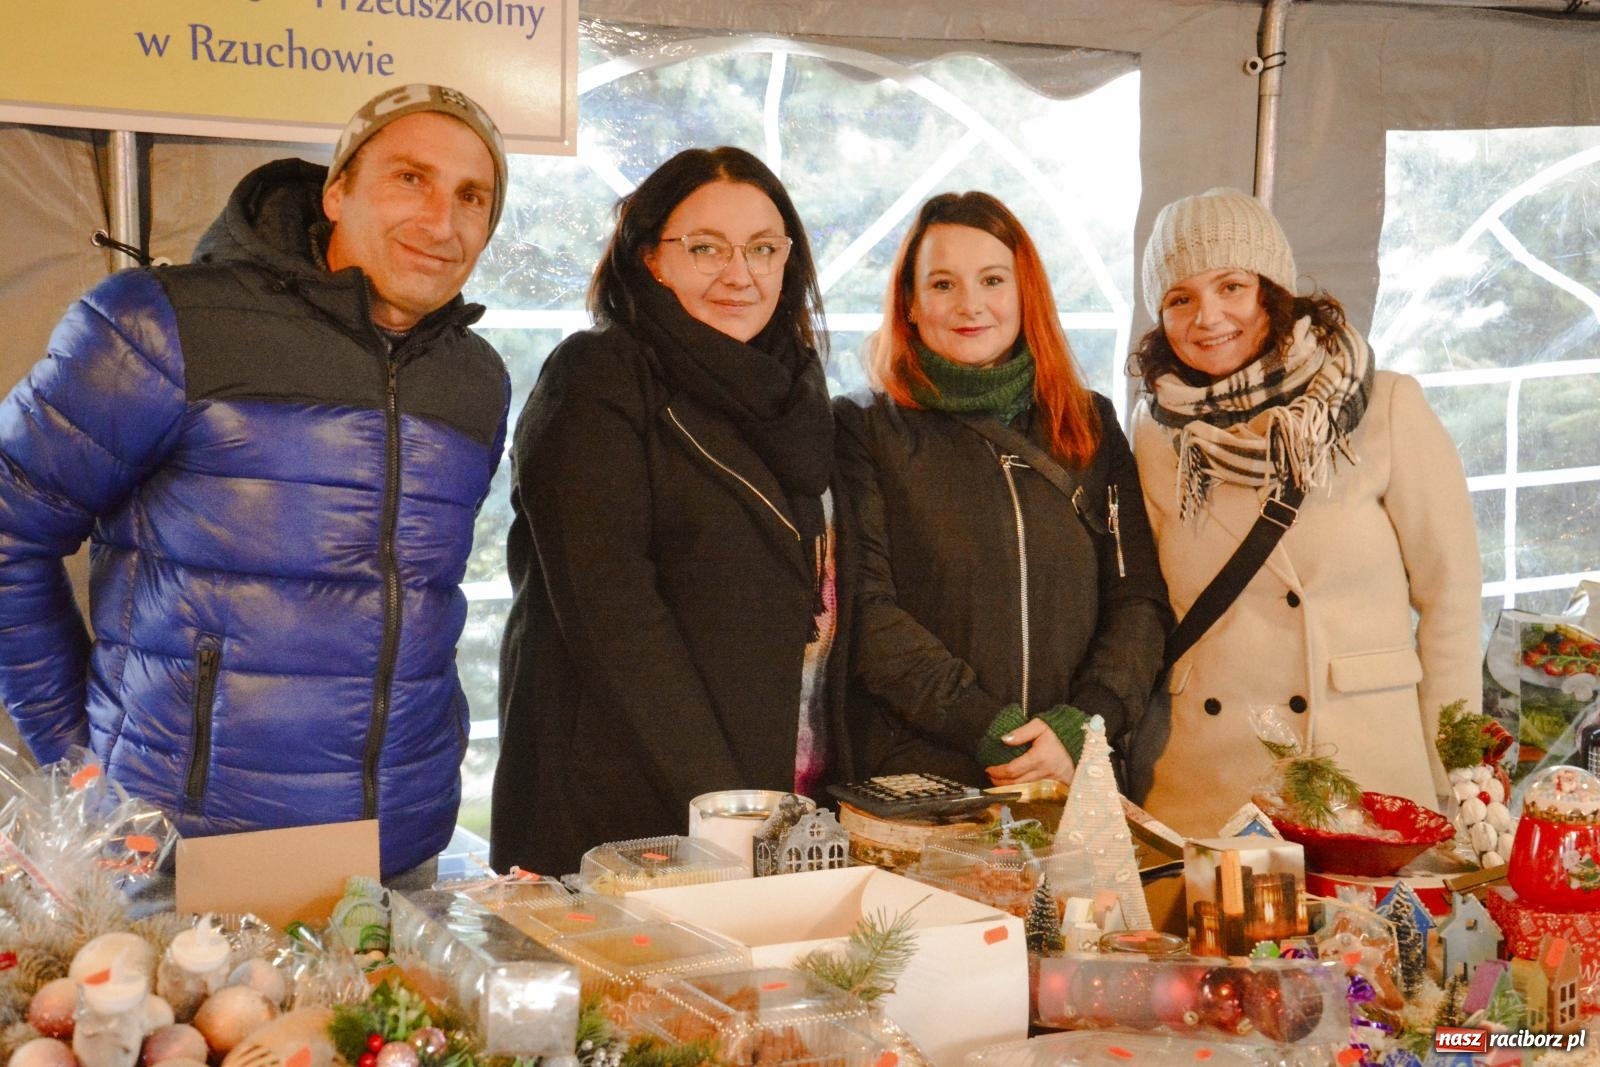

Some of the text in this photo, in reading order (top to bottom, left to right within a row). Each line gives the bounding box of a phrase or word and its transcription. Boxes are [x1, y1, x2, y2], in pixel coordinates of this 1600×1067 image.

[316, 0, 545, 39] zeszkolny
[135, 24, 394, 76] w Rzuchowie
